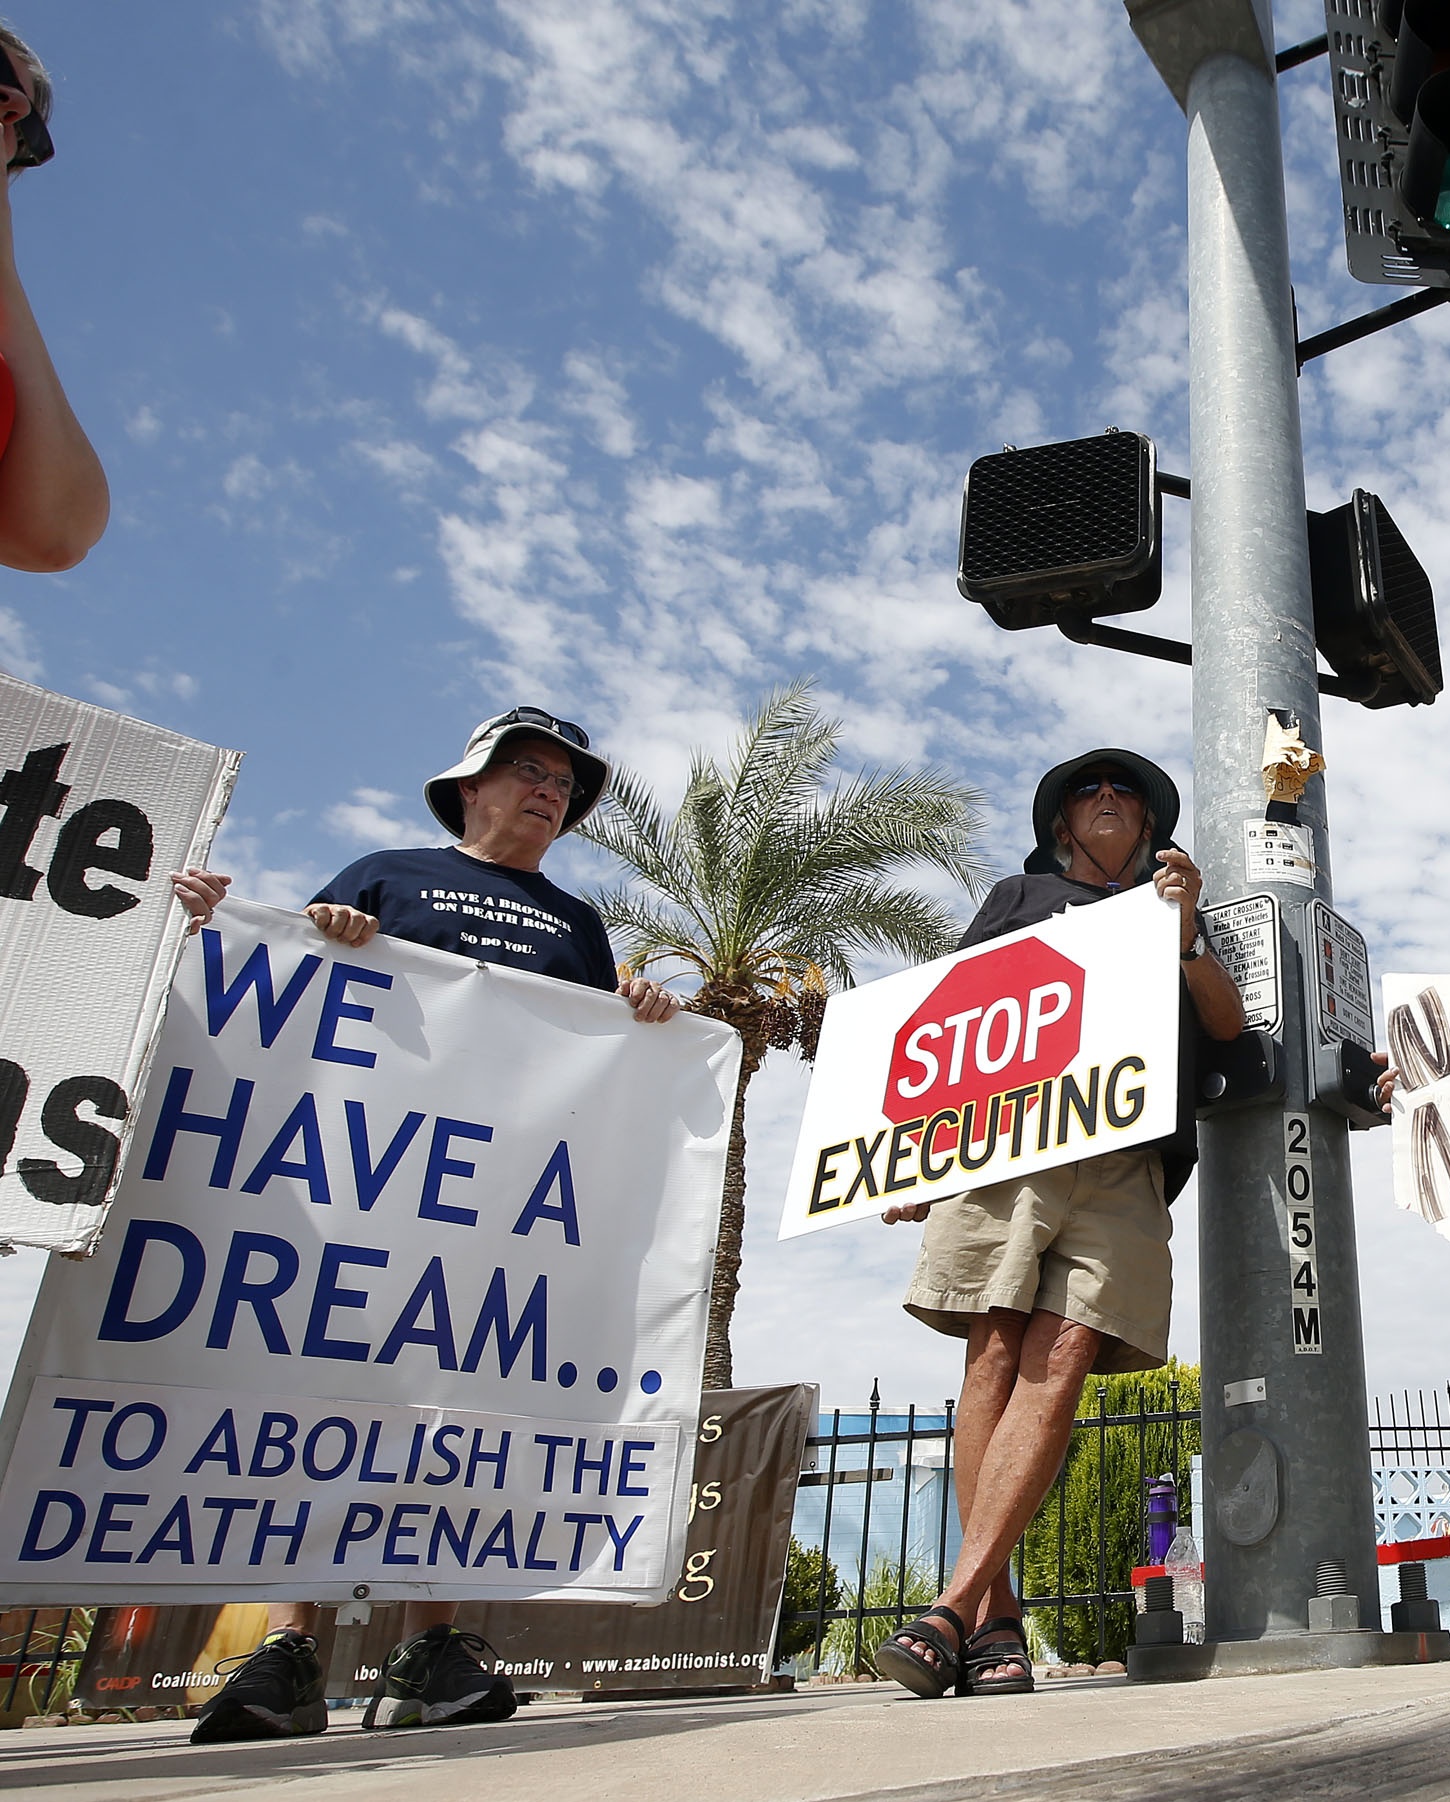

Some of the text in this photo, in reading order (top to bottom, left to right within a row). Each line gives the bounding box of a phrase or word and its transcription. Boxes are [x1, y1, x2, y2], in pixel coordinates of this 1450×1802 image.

[420, 889, 572, 933] I HAVE A BROTHER
[432, 902, 562, 938] ON DEATH ROW.
[1213, 900, 1264, 921] START CROSSING
[1232, 918, 1243, 928] For
[1244, 912, 1269, 924] Vehicles
[460, 931, 537, 955] SO DO YOU.
[1240, 938, 1264, 952] Crossing
[1242, 928, 1261, 940] START
[1233, 957, 1269, 974] REMAINING
[1234, 948, 1256, 961] Started
[1244, 967, 1270, 981] Crossing
[201, 928, 394, 1068] WE
[896, 980, 1072, 1099] STOP
[806, 1055, 1146, 1217] EXECUTING
[142, 1066, 581, 1246] HAVE A
[97, 1218, 664, 1395] DREAM...
[53, 1397, 656, 1497] TO ABOLISH THE
[18, 1489, 645, 1572] DEATH PENALTY
[494, 1658, 554, 1678] Penalty
[582, 1651, 768, 1673] www.azabolitionist.org
[151, 1671, 219, 1689] Coalition
